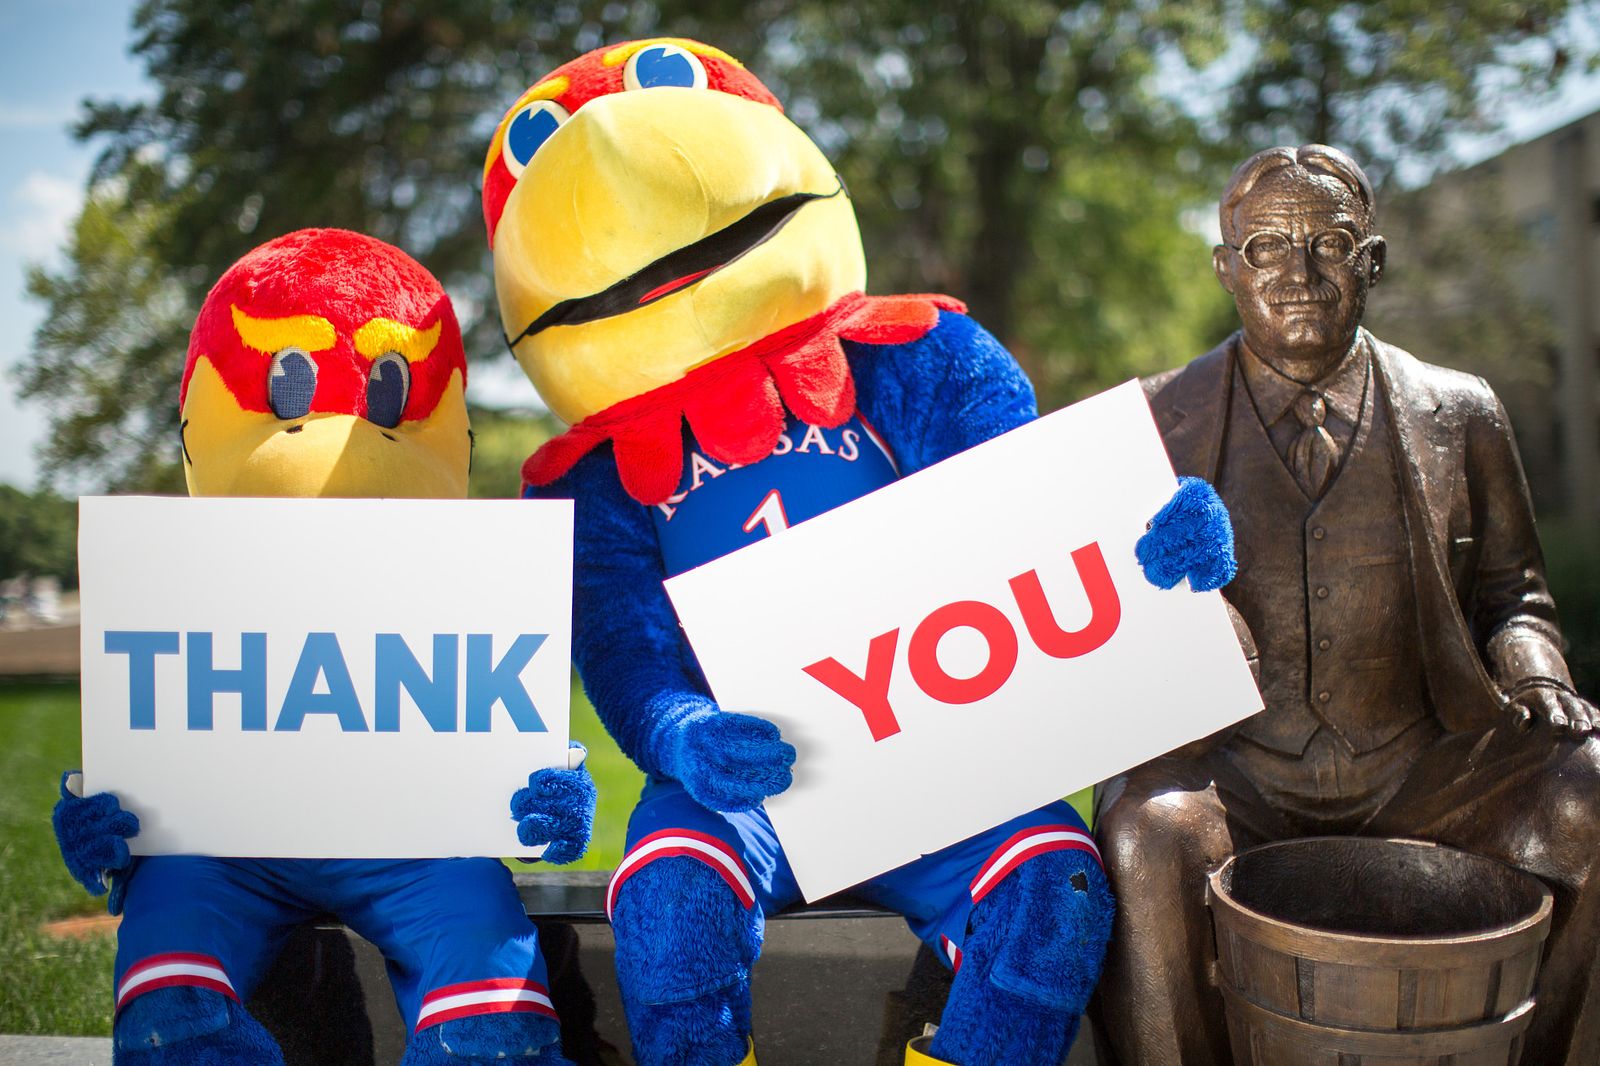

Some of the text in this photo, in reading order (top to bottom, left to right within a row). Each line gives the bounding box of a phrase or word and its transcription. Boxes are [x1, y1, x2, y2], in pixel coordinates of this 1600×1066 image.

[657, 424, 860, 521] KASAS
[104, 631, 549, 733] THANK
[802, 541, 1121, 742] YOU
